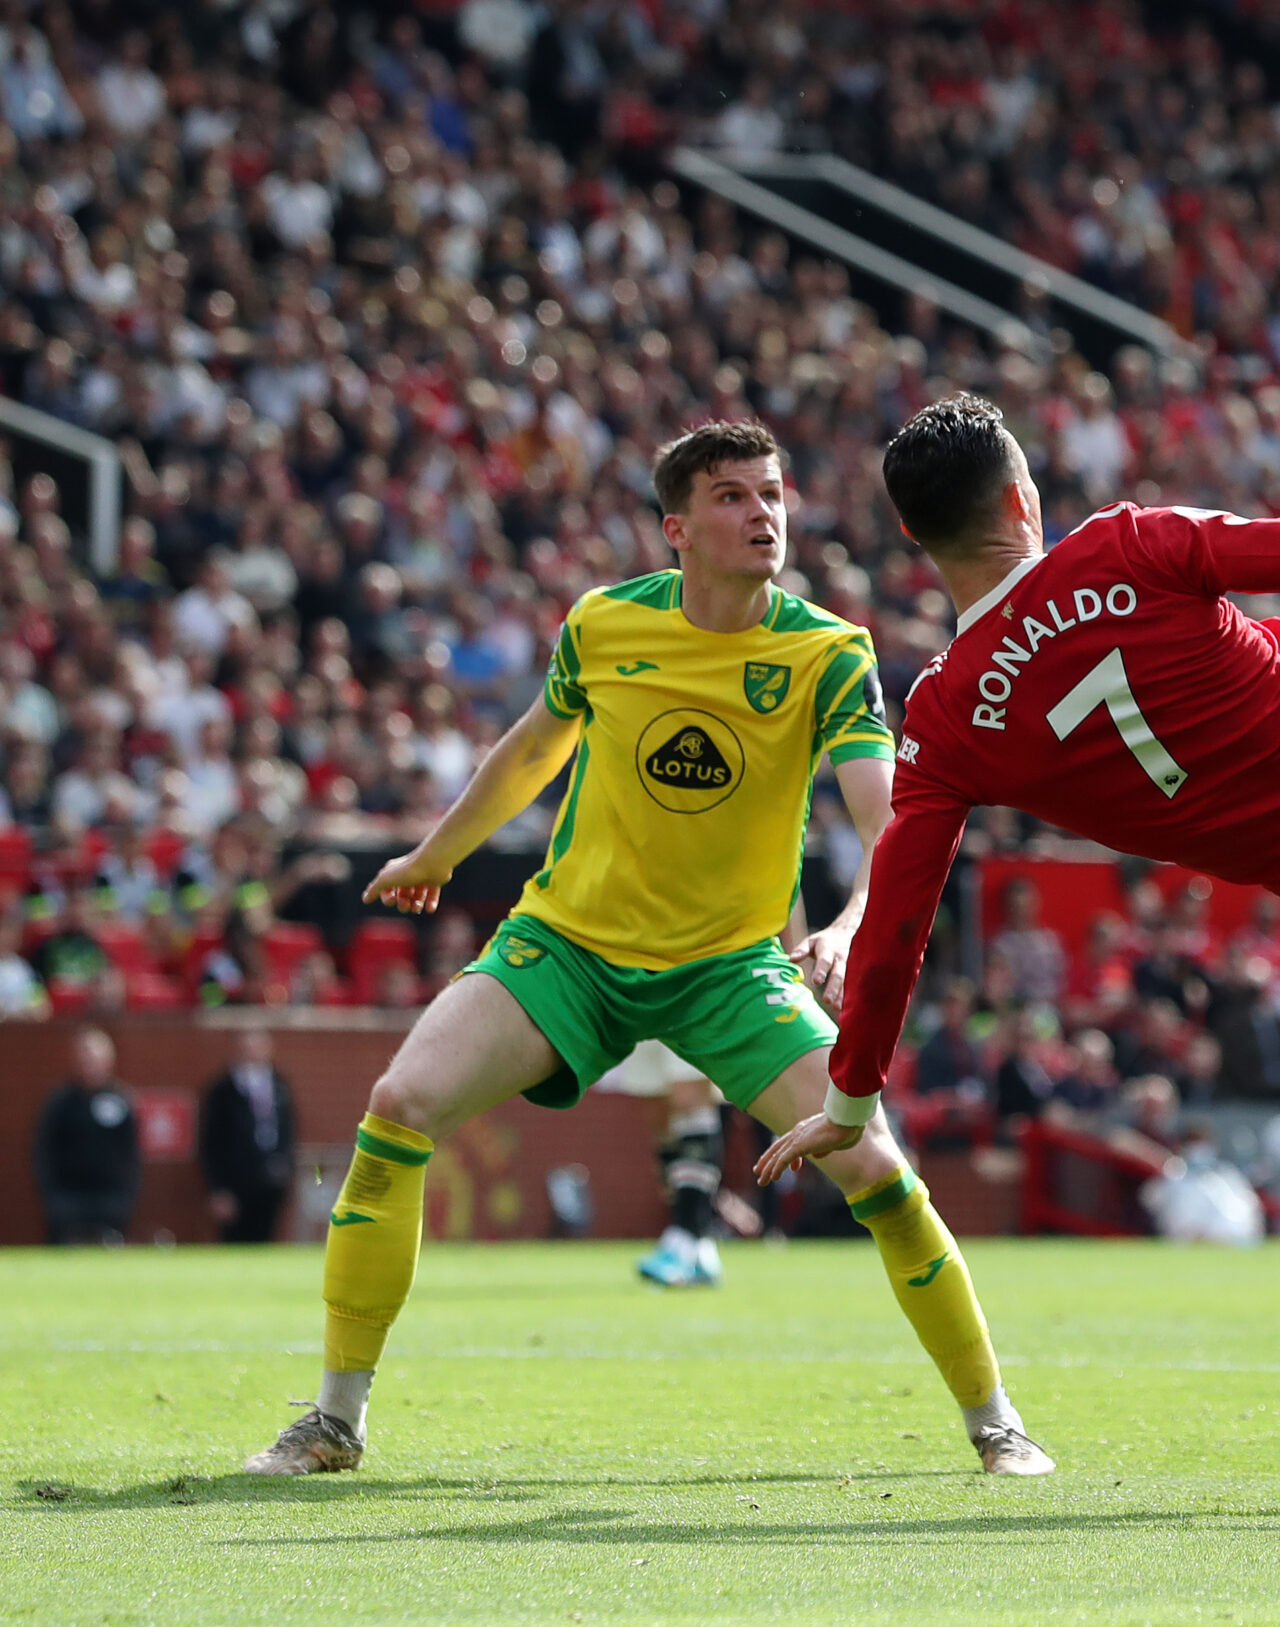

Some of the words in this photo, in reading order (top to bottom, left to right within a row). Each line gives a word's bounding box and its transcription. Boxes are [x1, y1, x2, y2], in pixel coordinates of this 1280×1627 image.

[972, 583, 1137, 730] RONALDO
[1045, 646, 1189, 799] 7
[652, 757, 726, 784] LOTUS
